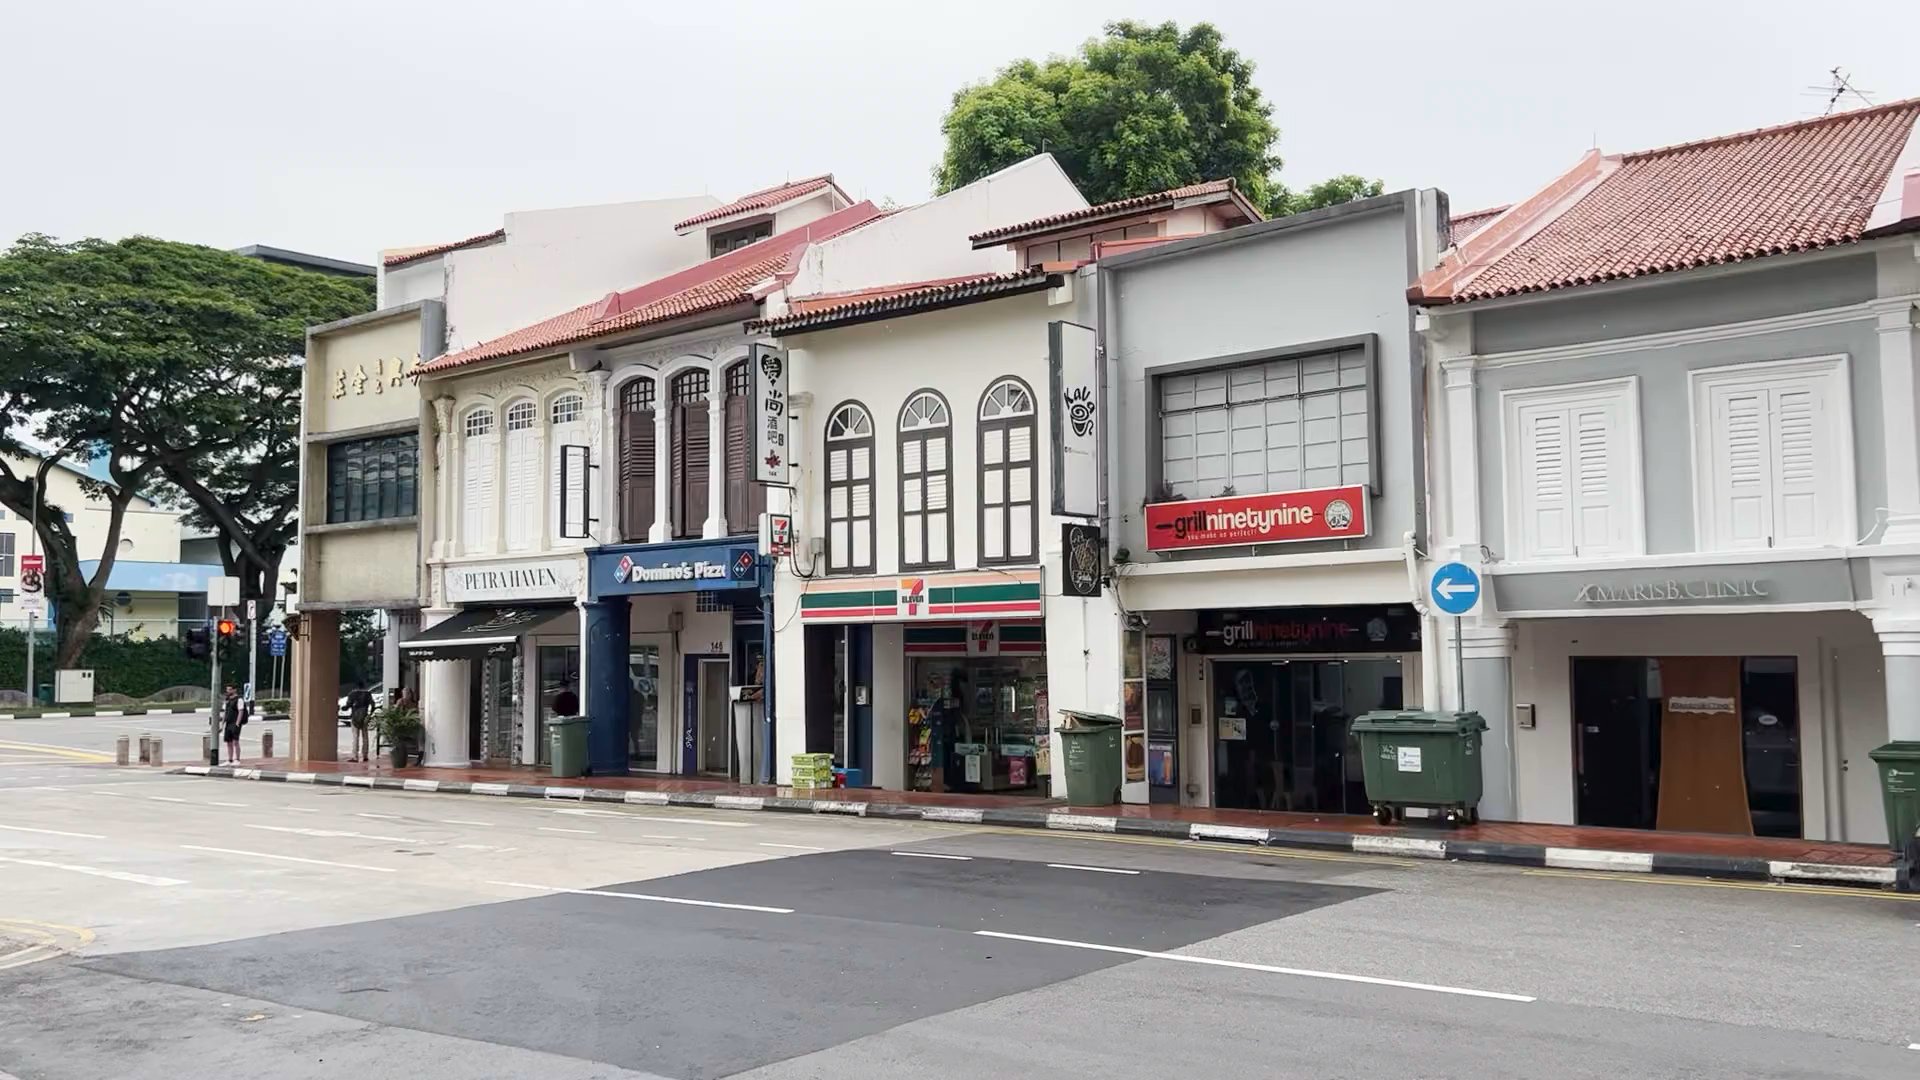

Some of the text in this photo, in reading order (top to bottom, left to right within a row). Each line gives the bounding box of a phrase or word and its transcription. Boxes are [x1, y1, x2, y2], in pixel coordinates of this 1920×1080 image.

[465, 567, 556, 590] PETRA HAVEN
[632, 562, 693, 582] Domino's
